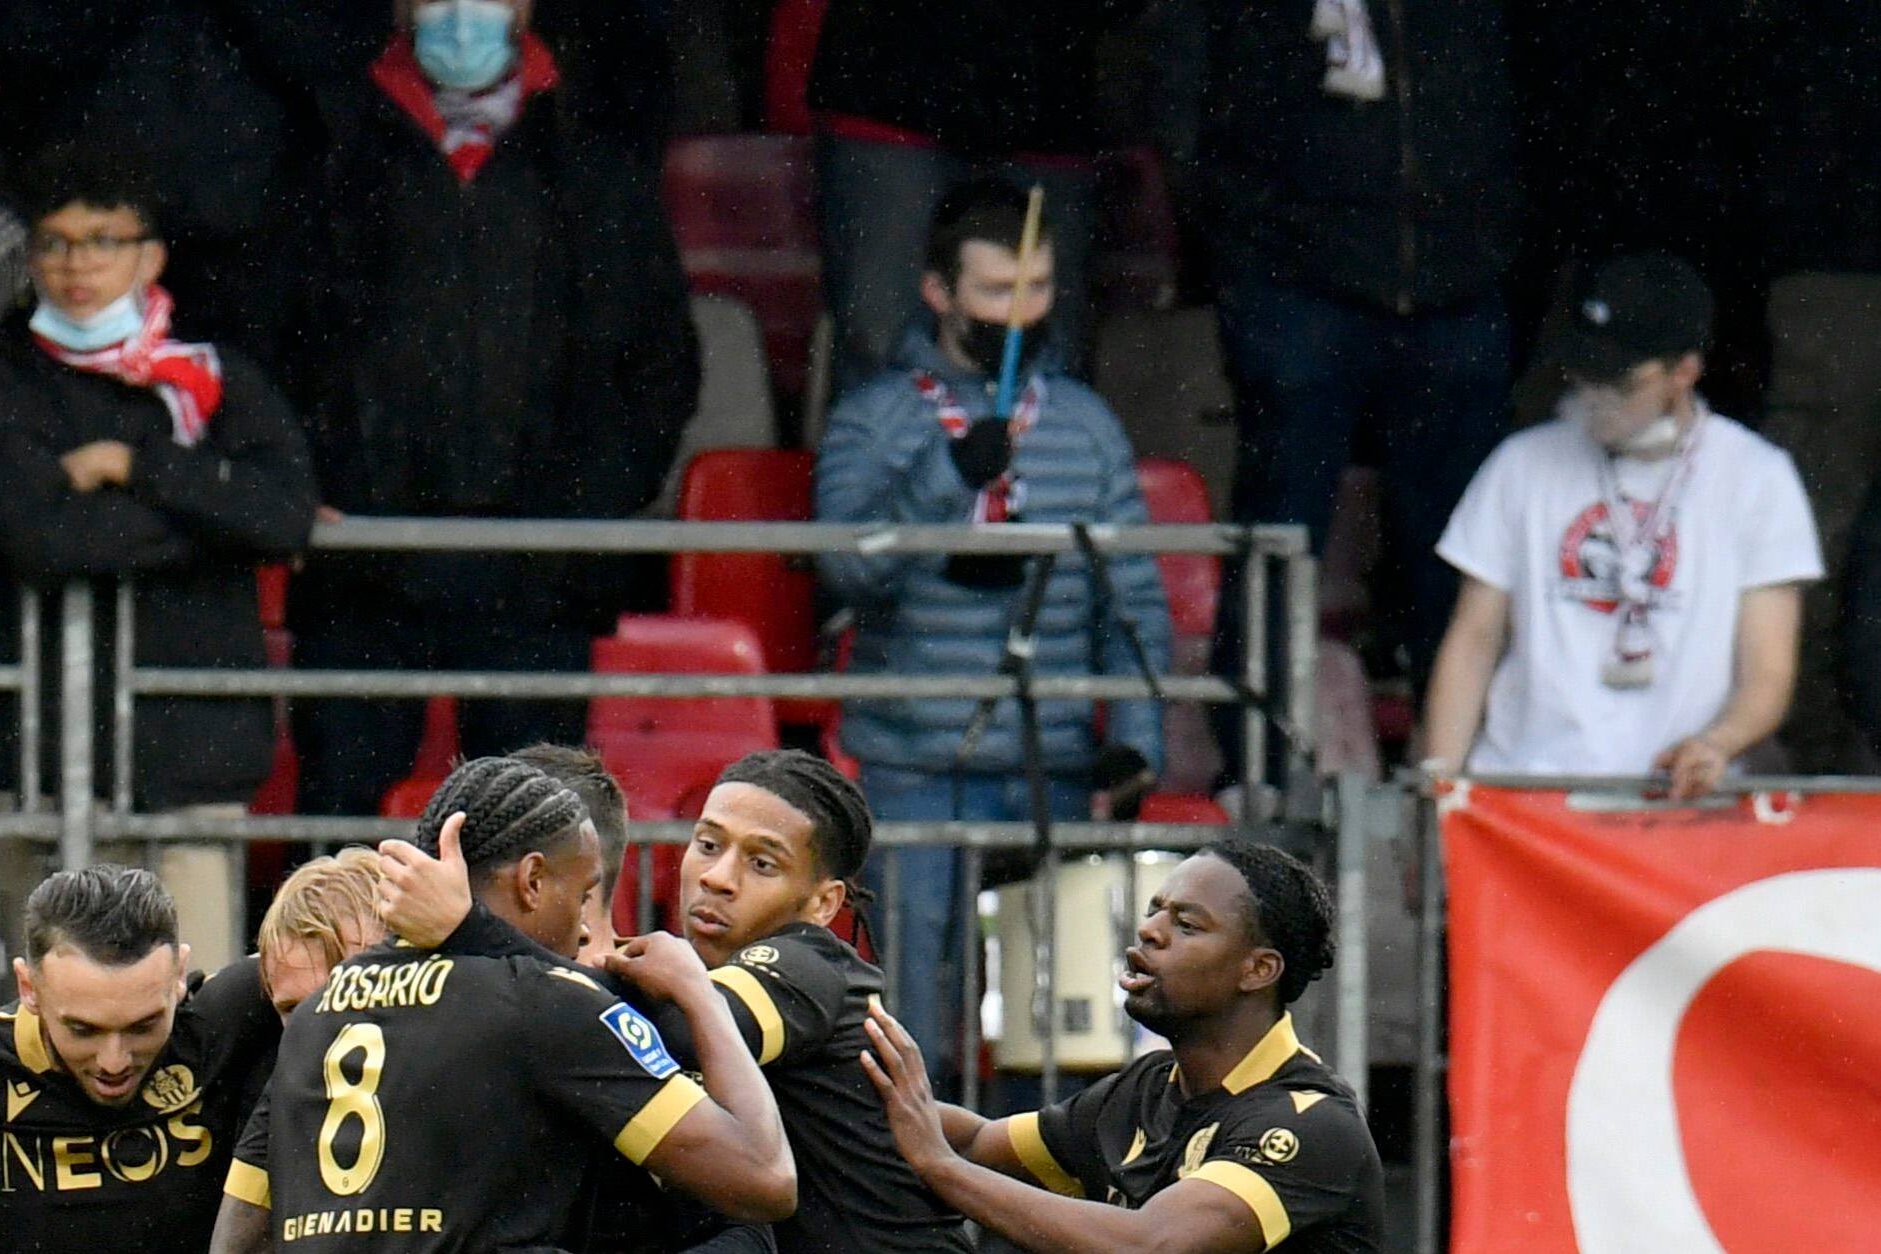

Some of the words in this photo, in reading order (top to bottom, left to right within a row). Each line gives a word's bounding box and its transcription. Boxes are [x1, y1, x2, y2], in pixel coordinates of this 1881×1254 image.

[315, 953, 454, 1014] ROSARIO
[319, 1022, 386, 1195] 8
[284, 1208, 443, 1241] GENADIER
